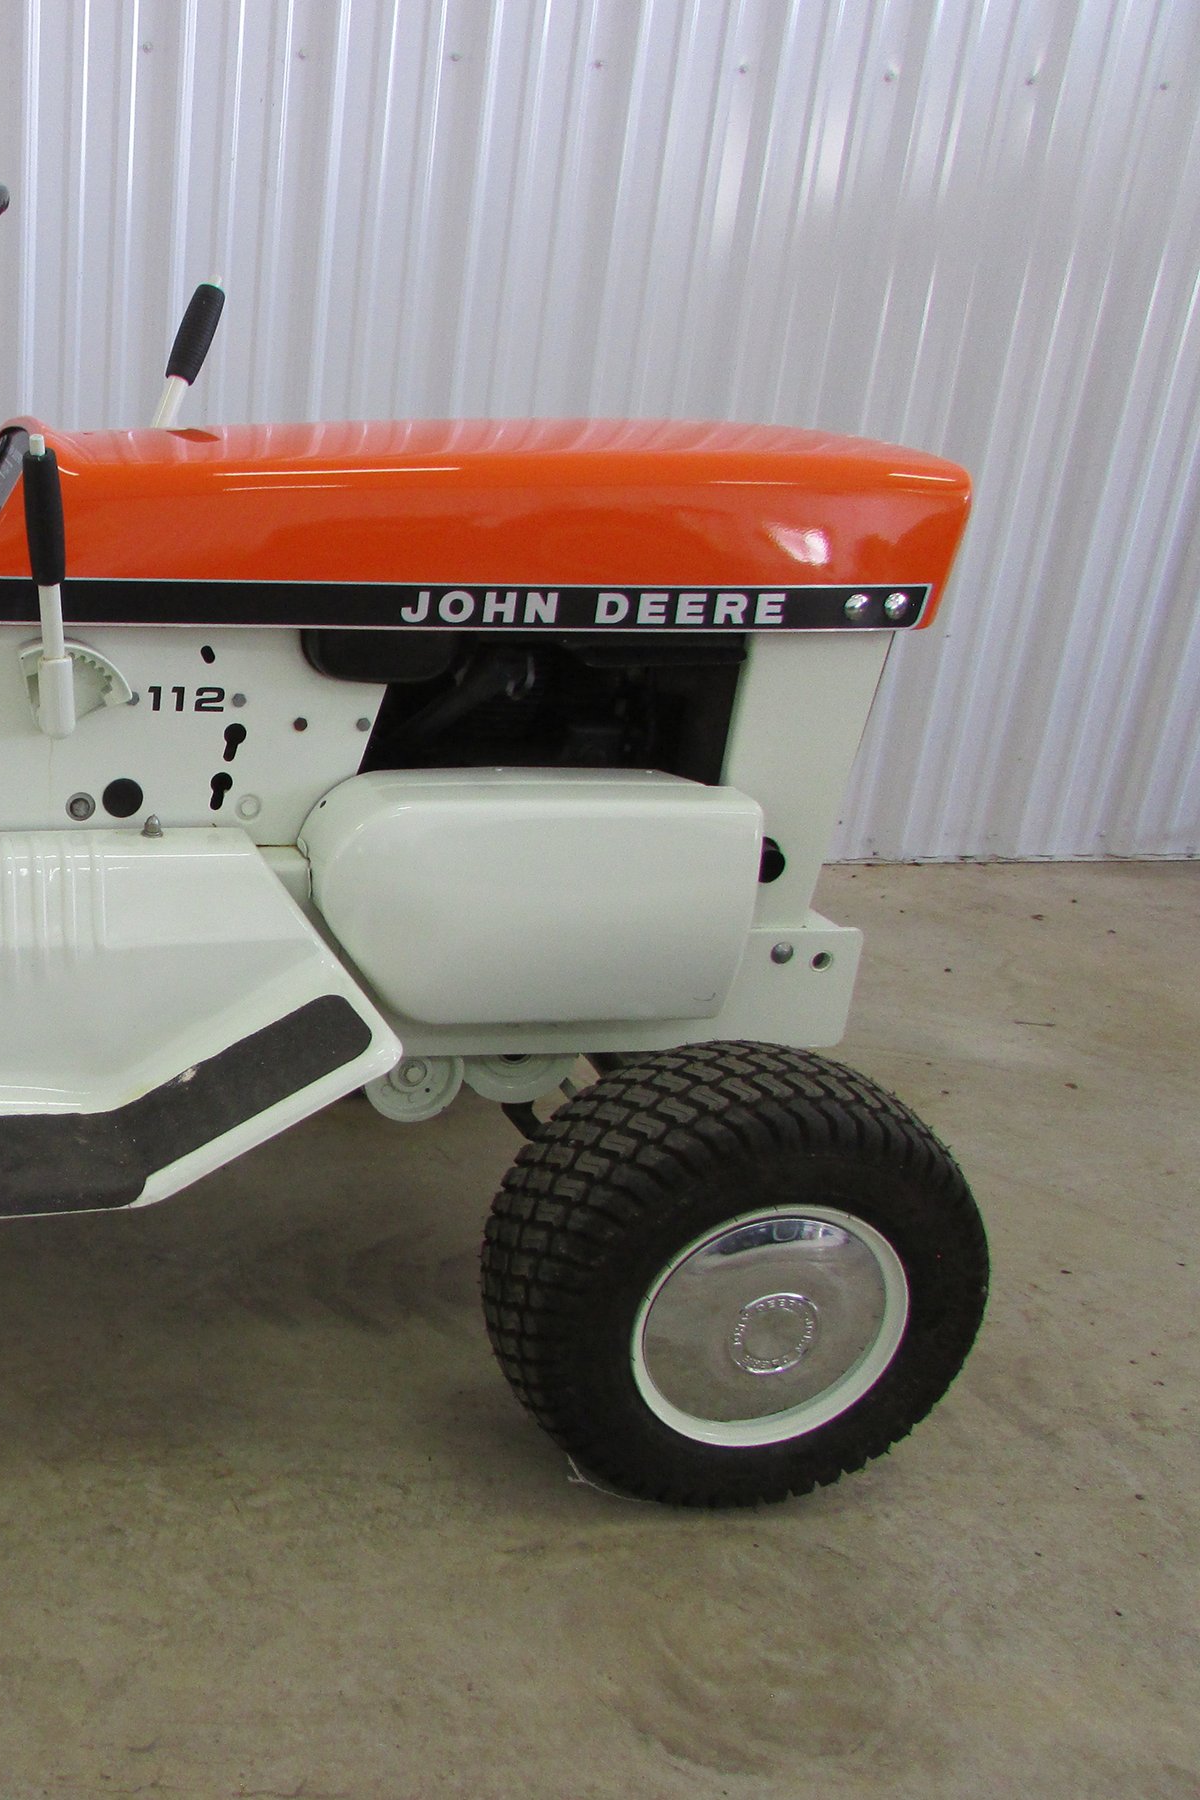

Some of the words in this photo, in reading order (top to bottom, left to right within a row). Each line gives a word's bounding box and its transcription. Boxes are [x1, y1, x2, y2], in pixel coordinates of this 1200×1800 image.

[400, 590, 560, 624] JOHN
[594, 592, 787, 626] DEERE
[147, 685, 226, 713] 112
